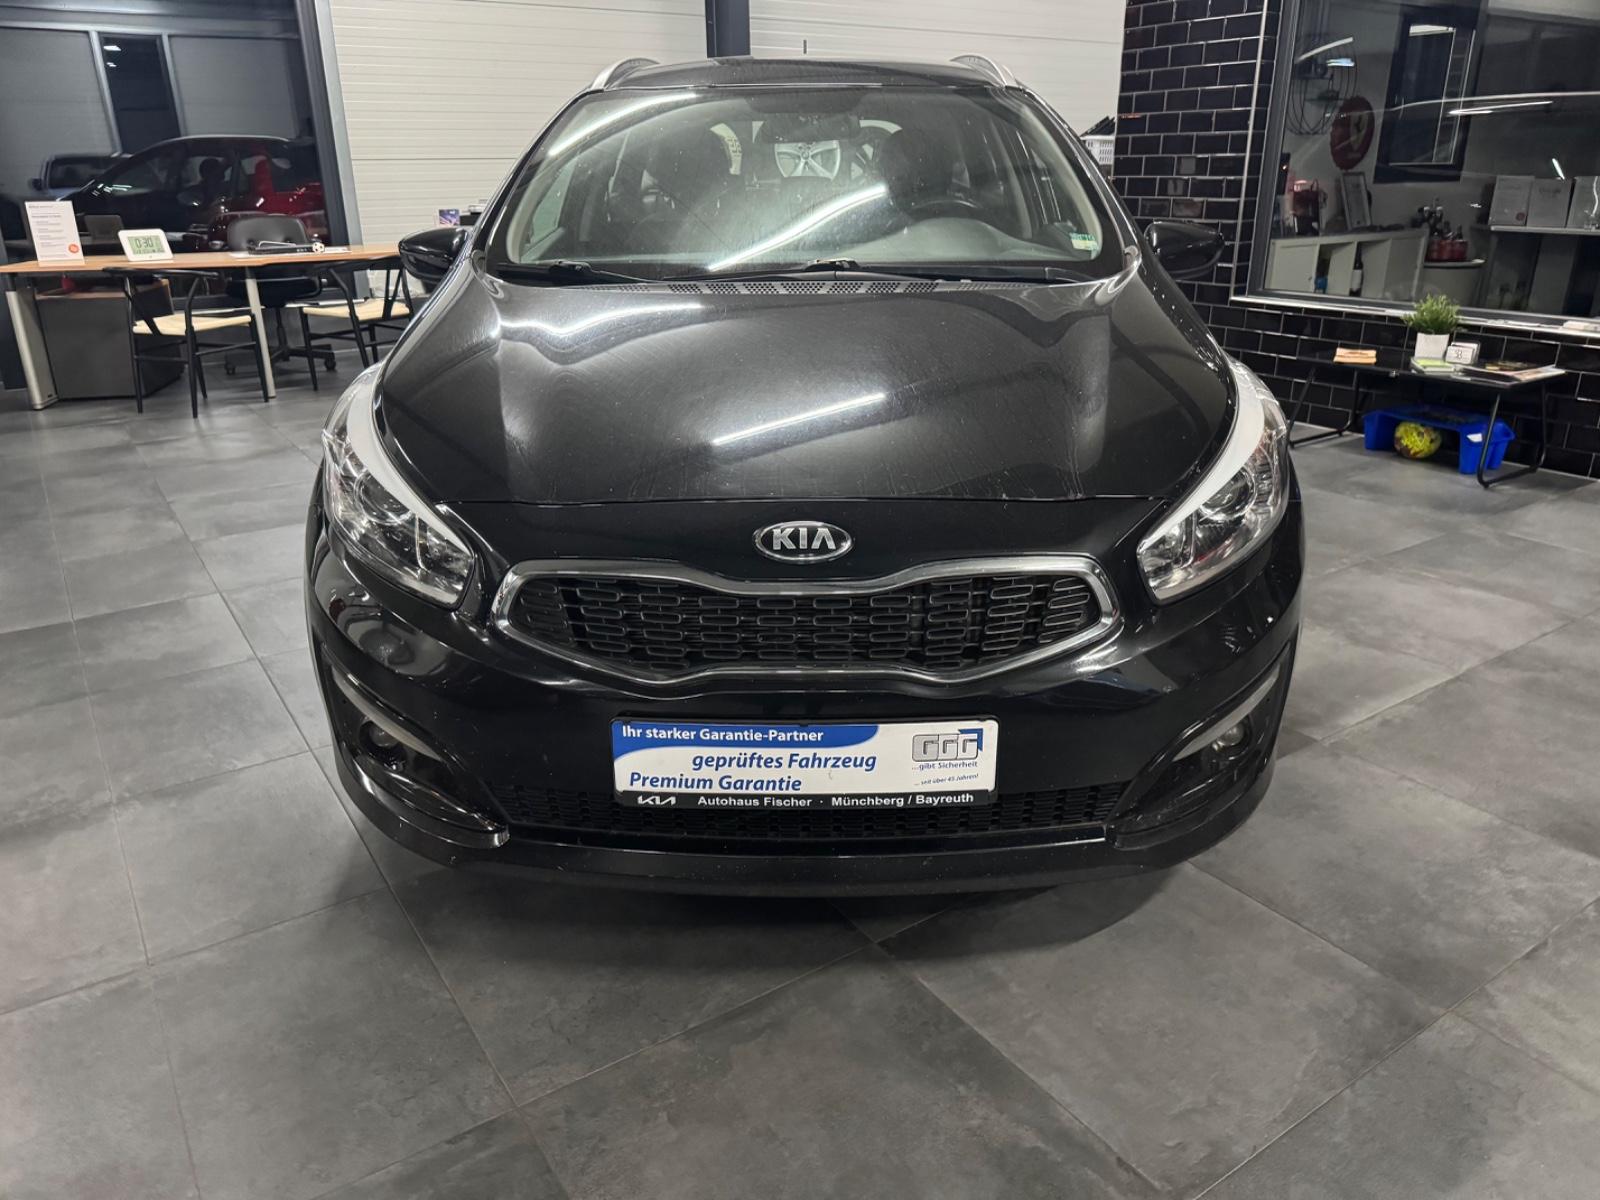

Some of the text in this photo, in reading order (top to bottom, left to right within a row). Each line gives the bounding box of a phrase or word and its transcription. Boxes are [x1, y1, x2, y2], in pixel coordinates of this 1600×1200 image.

[772, 527, 836, 551] KIA
[622, 725, 824, 742] Ihr starker Garantie-Partner
[692, 752, 877, 772] geprüftes Fahrzeug
[938, 761, 978, 769] Sicherheit
[629, 772, 802, 791] Premium Garantie
[698, 796, 760, 807] Autohaus
[763, 797, 812, 807] Fischer
[831, 796, 904, 807] Münchberg
[915, 793, 974, 805] Bayreuth
